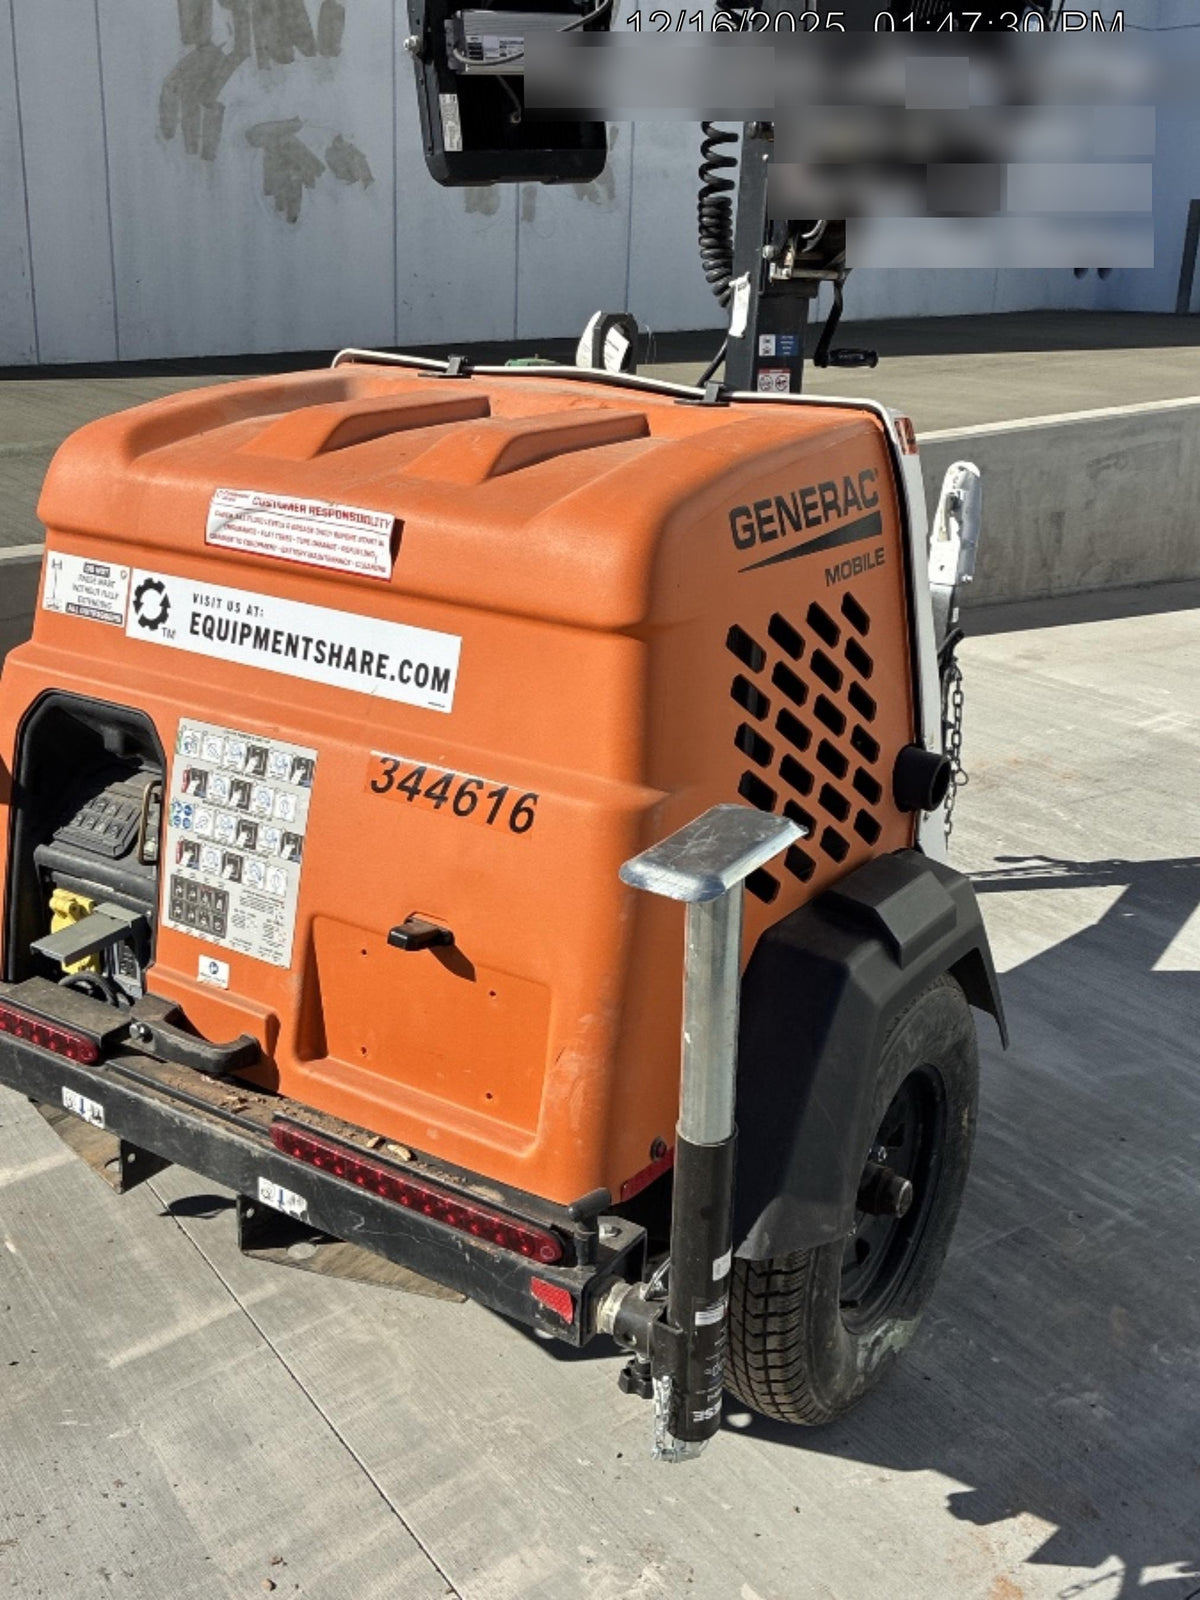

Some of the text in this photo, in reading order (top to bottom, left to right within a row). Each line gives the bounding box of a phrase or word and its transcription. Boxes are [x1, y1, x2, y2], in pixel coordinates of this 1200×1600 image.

[252, 496, 306, 514] CUSTOMER
[309, 504, 392, 529] RESPONSIBILITY
[728, 469, 880, 550] GENERAC
[824, 547, 886, 588] MOBILE
[192, 593, 264, 618] VISIT US AT:
[189, 611, 451, 694] EQUIPMENTSHARE.COM
[370, 756, 540, 834] 344616
